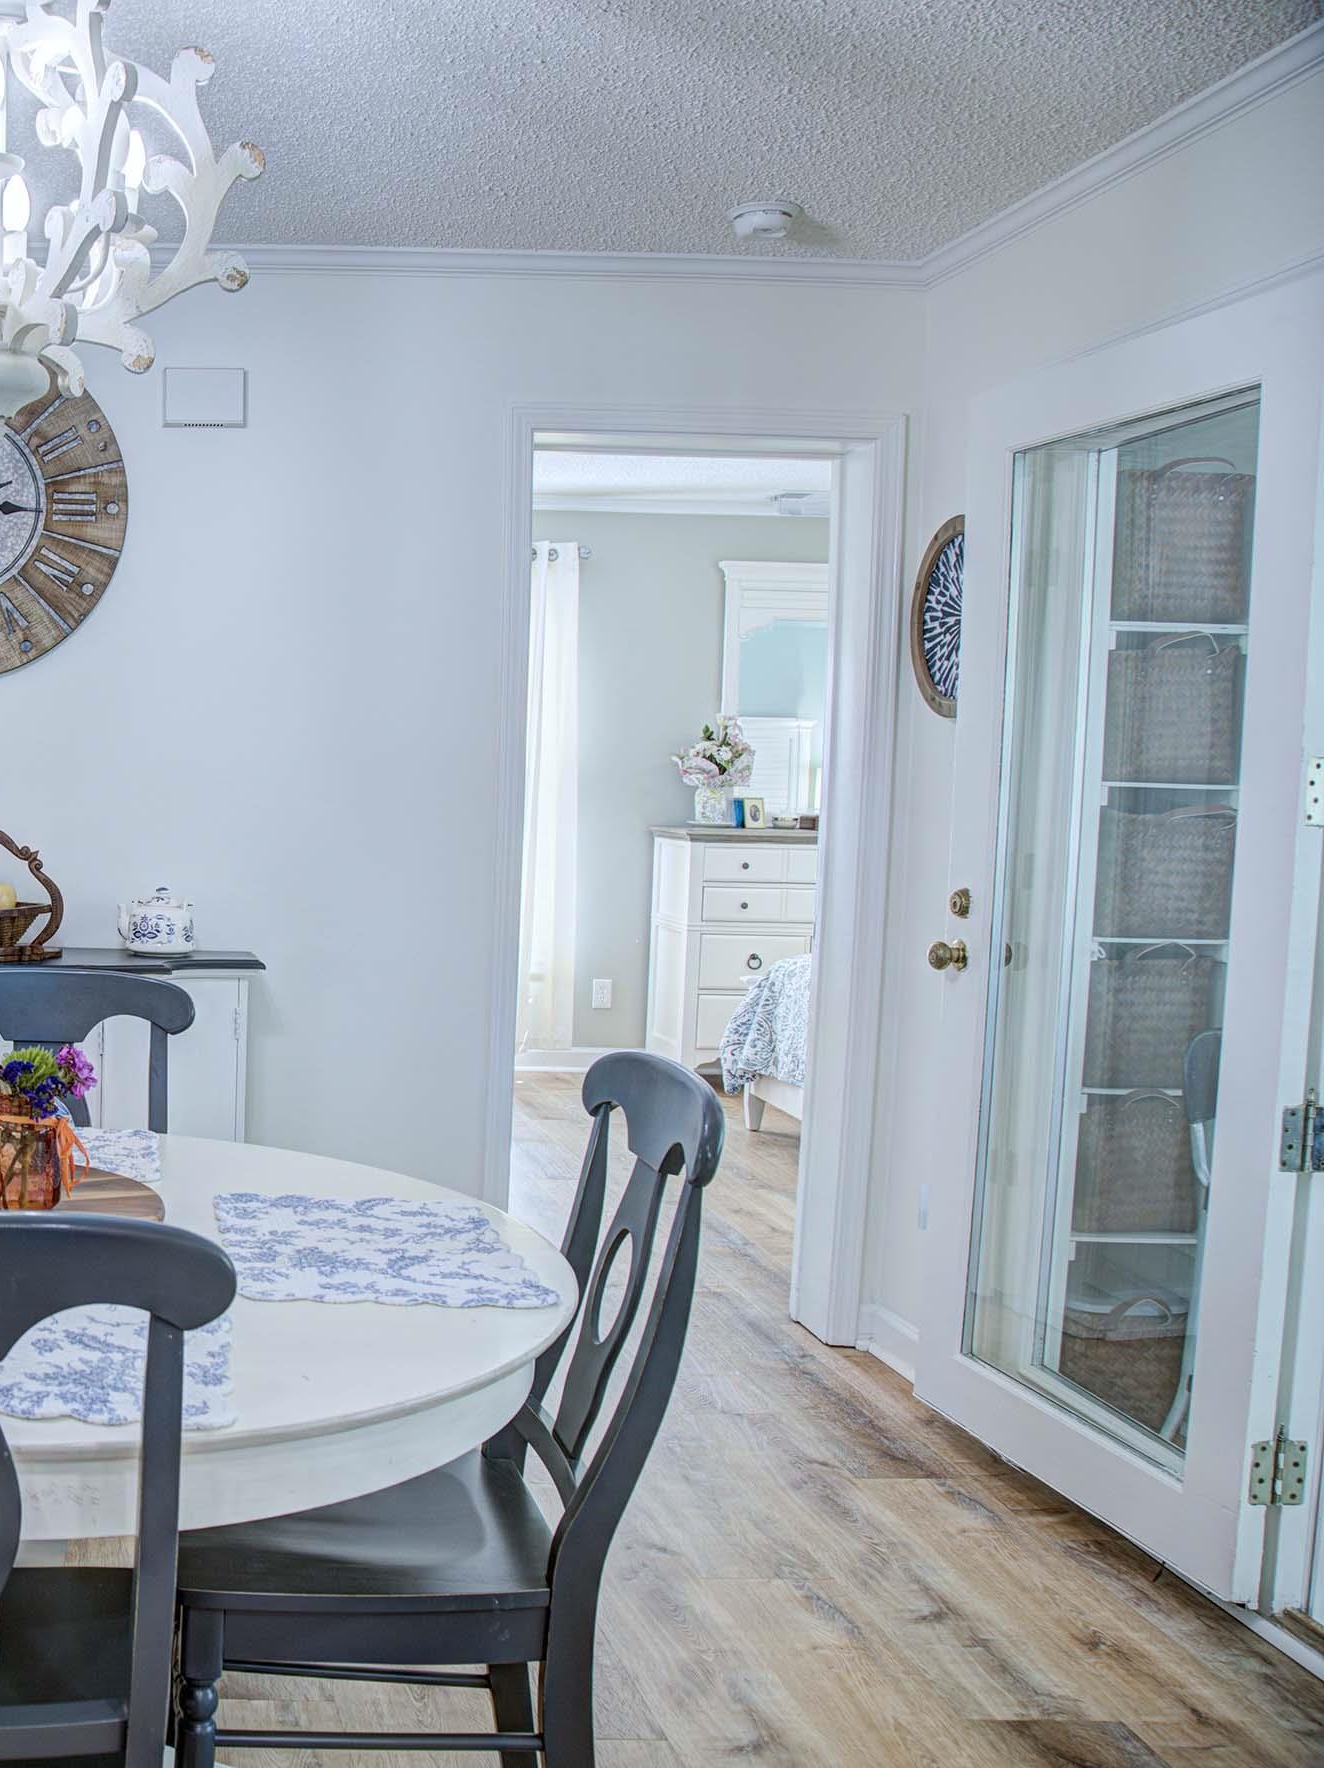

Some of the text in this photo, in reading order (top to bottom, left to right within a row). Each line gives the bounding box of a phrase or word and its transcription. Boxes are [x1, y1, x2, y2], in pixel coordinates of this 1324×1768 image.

[37, 425, 84, 464] II
[52, 490, 97, 522] III
[33, 545, 81, 592] IV
